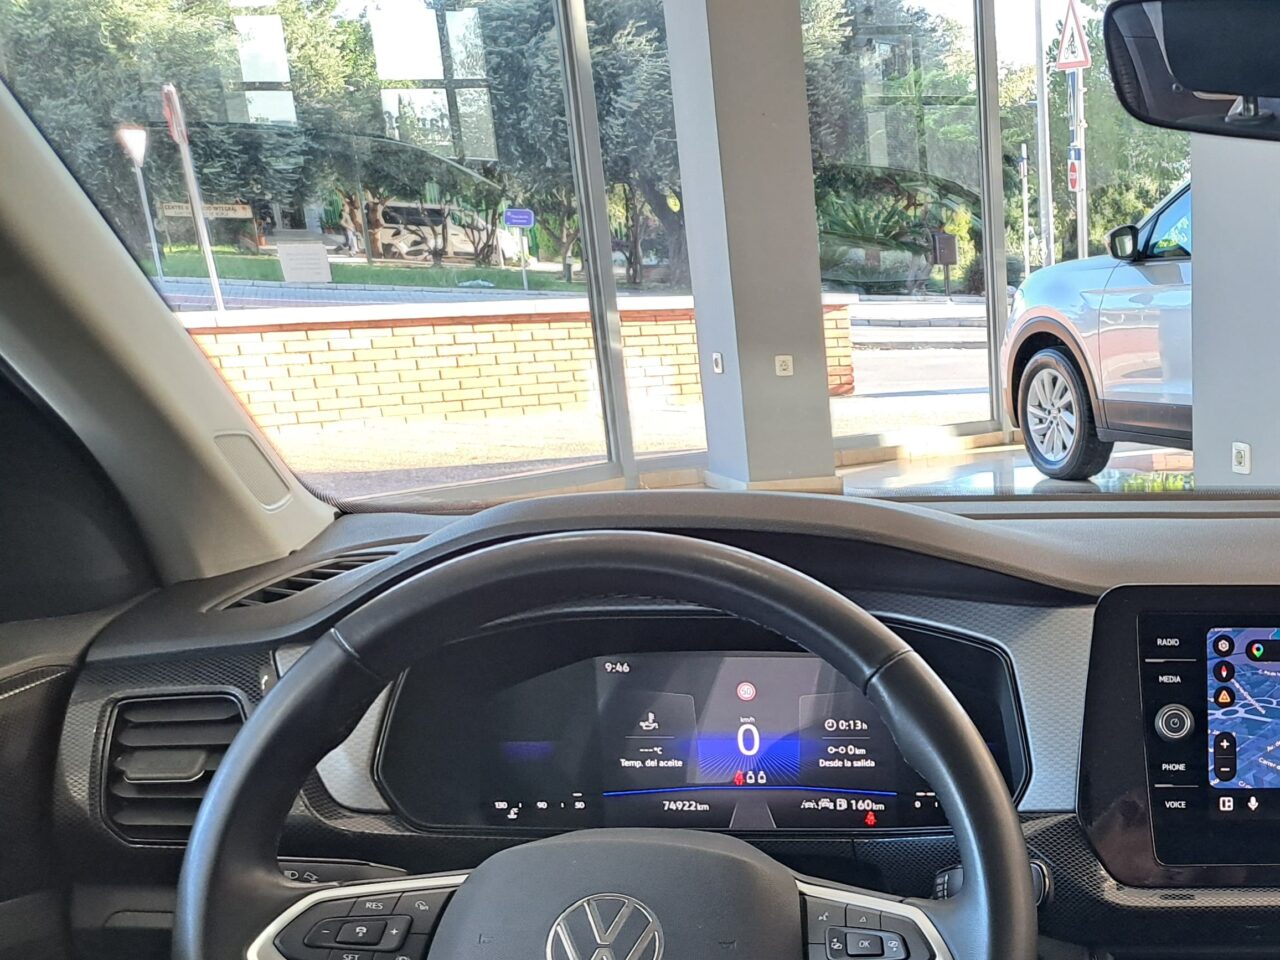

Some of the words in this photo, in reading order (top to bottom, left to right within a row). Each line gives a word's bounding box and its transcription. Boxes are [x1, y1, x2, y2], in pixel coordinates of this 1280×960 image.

[1157, 638, 1180, 646] RADIO
[605, 663, 630, 673] 9:46
[1159, 675, 1181, 683] MEDIA
[737, 723, 760, 756] 0
[620, 758, 643, 768] Temp.
[645, 758, 658, 767] del
[659, 758, 683, 767] aceite
[819, 759, 843, 768] Desde
[844, 759, 851, 767] la
[853, 759, 876, 767] salida
[1162, 763, 1186, 771] PHONE
[537, 801, 547, 809] 90
[1165, 800, 1186, 808] VOICE
[365, 902, 383, 910] RES
[859, 940, 871, 948] OK
